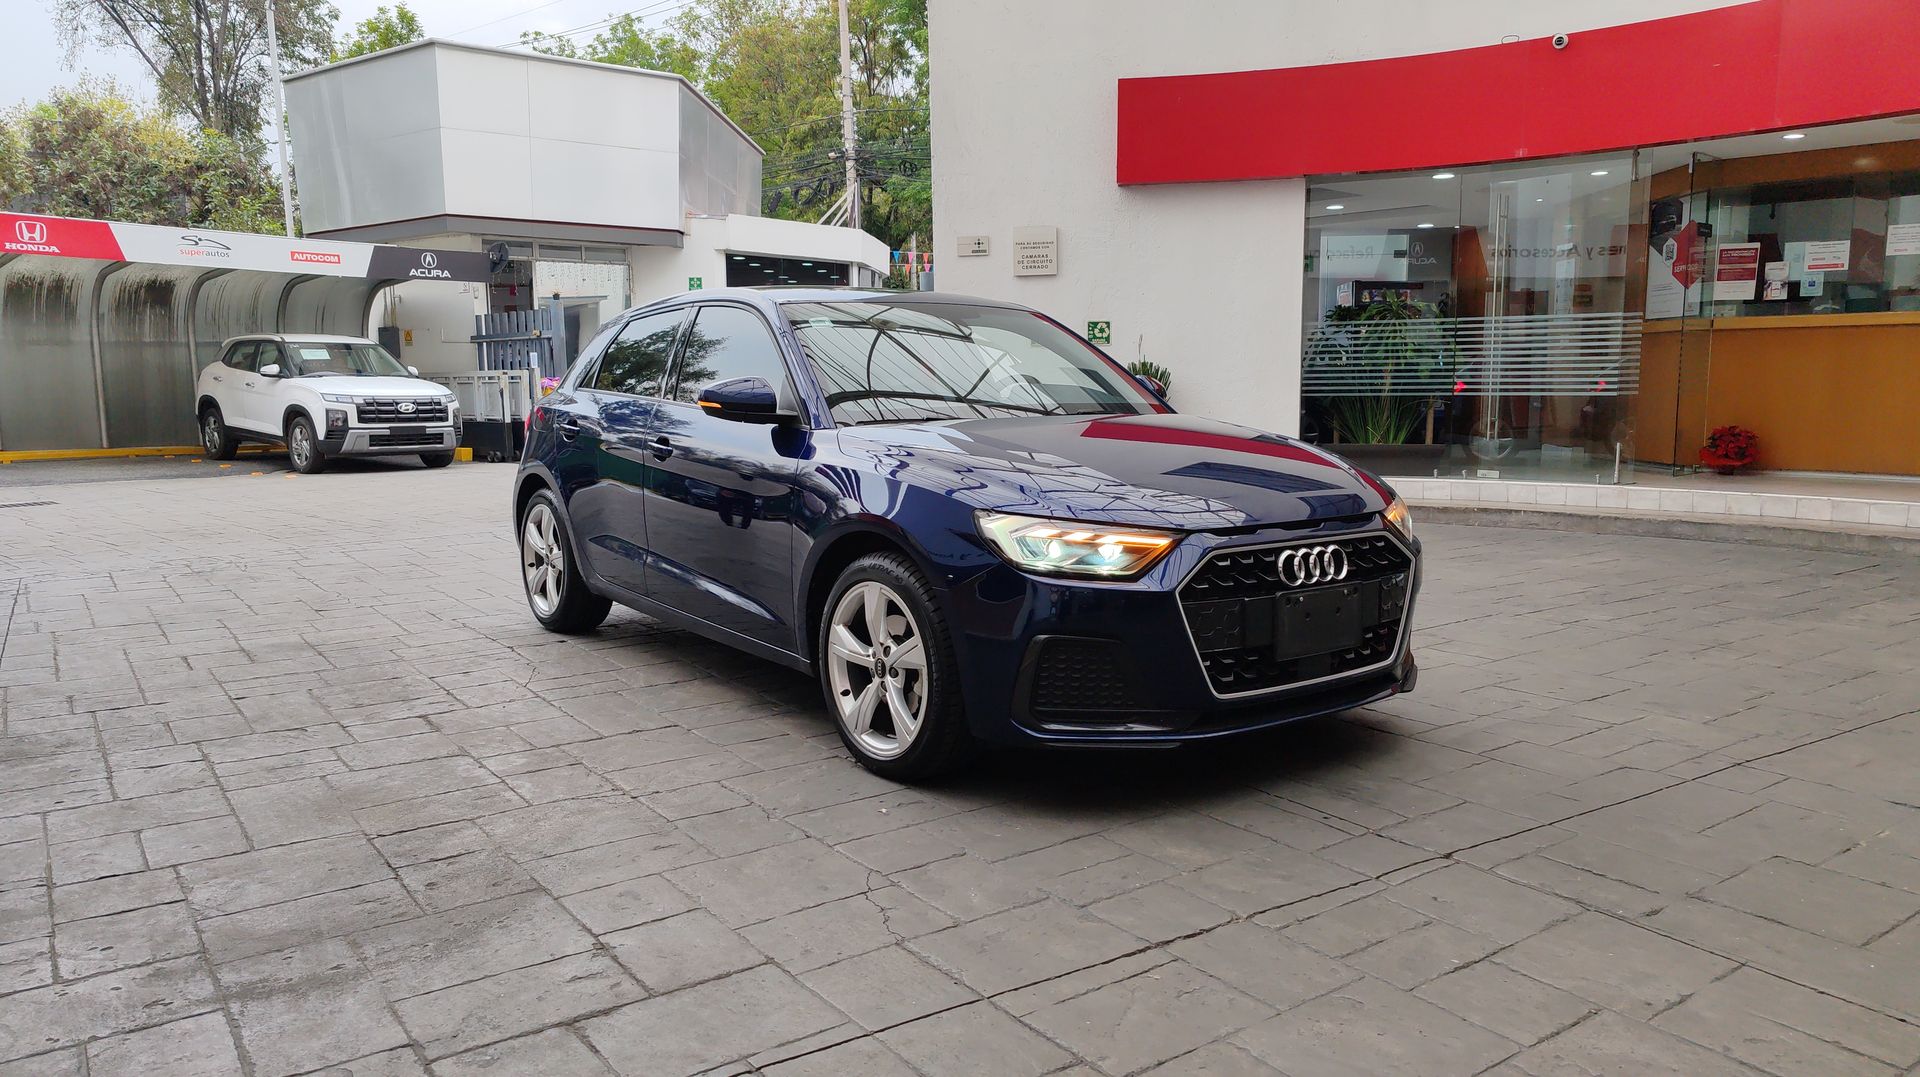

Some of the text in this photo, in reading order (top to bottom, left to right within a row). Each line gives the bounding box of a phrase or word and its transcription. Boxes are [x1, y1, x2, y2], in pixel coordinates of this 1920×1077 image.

[4, 242, 61, 253] HONDA
[179, 247, 230, 258] superautos
[293, 253, 339, 263] AUTOCOM
[409, 268, 452, 279] ACURA
